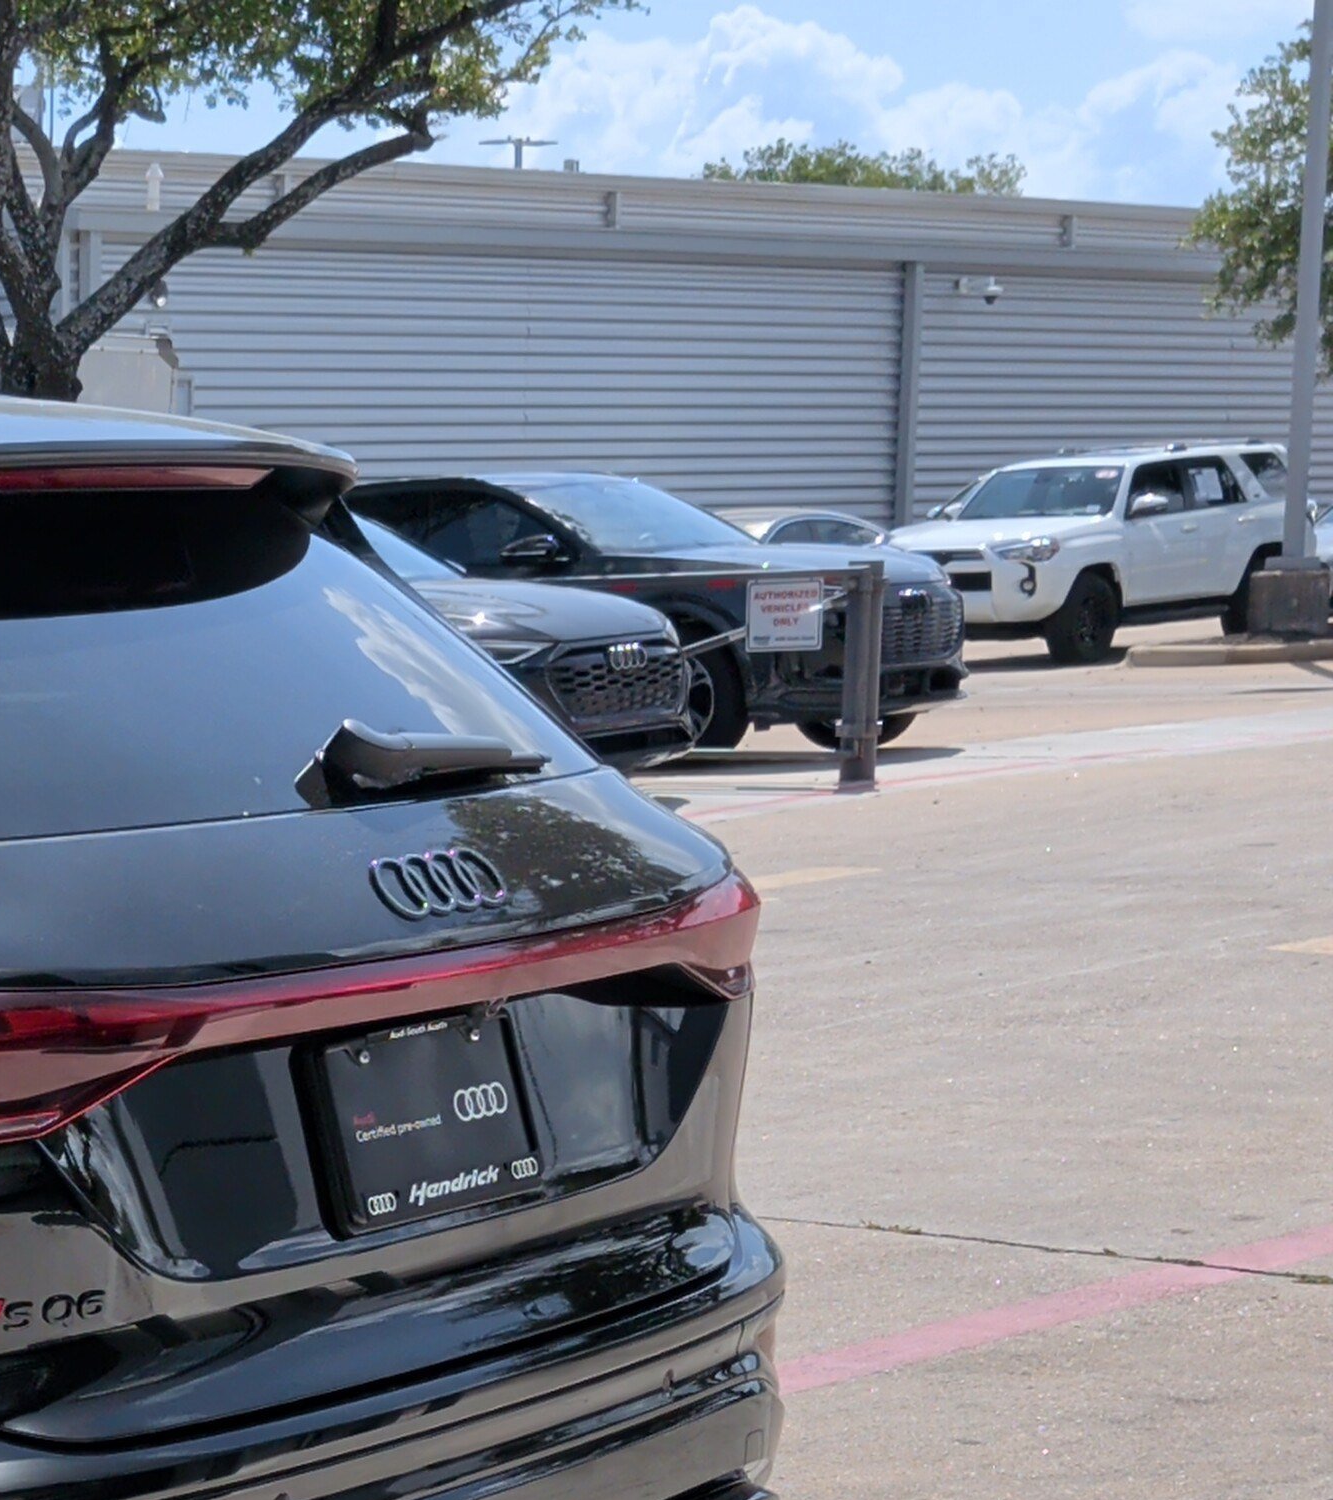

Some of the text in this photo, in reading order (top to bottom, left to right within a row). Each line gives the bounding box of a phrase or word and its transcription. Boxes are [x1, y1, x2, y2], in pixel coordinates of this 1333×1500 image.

[753, 589, 818, 601] AUTHORIZED
[772, 616, 800, 627] ONLY
[355, 1113, 442, 1143] Certified pre-owned
[408, 1164, 499, 1206] Hendrick
